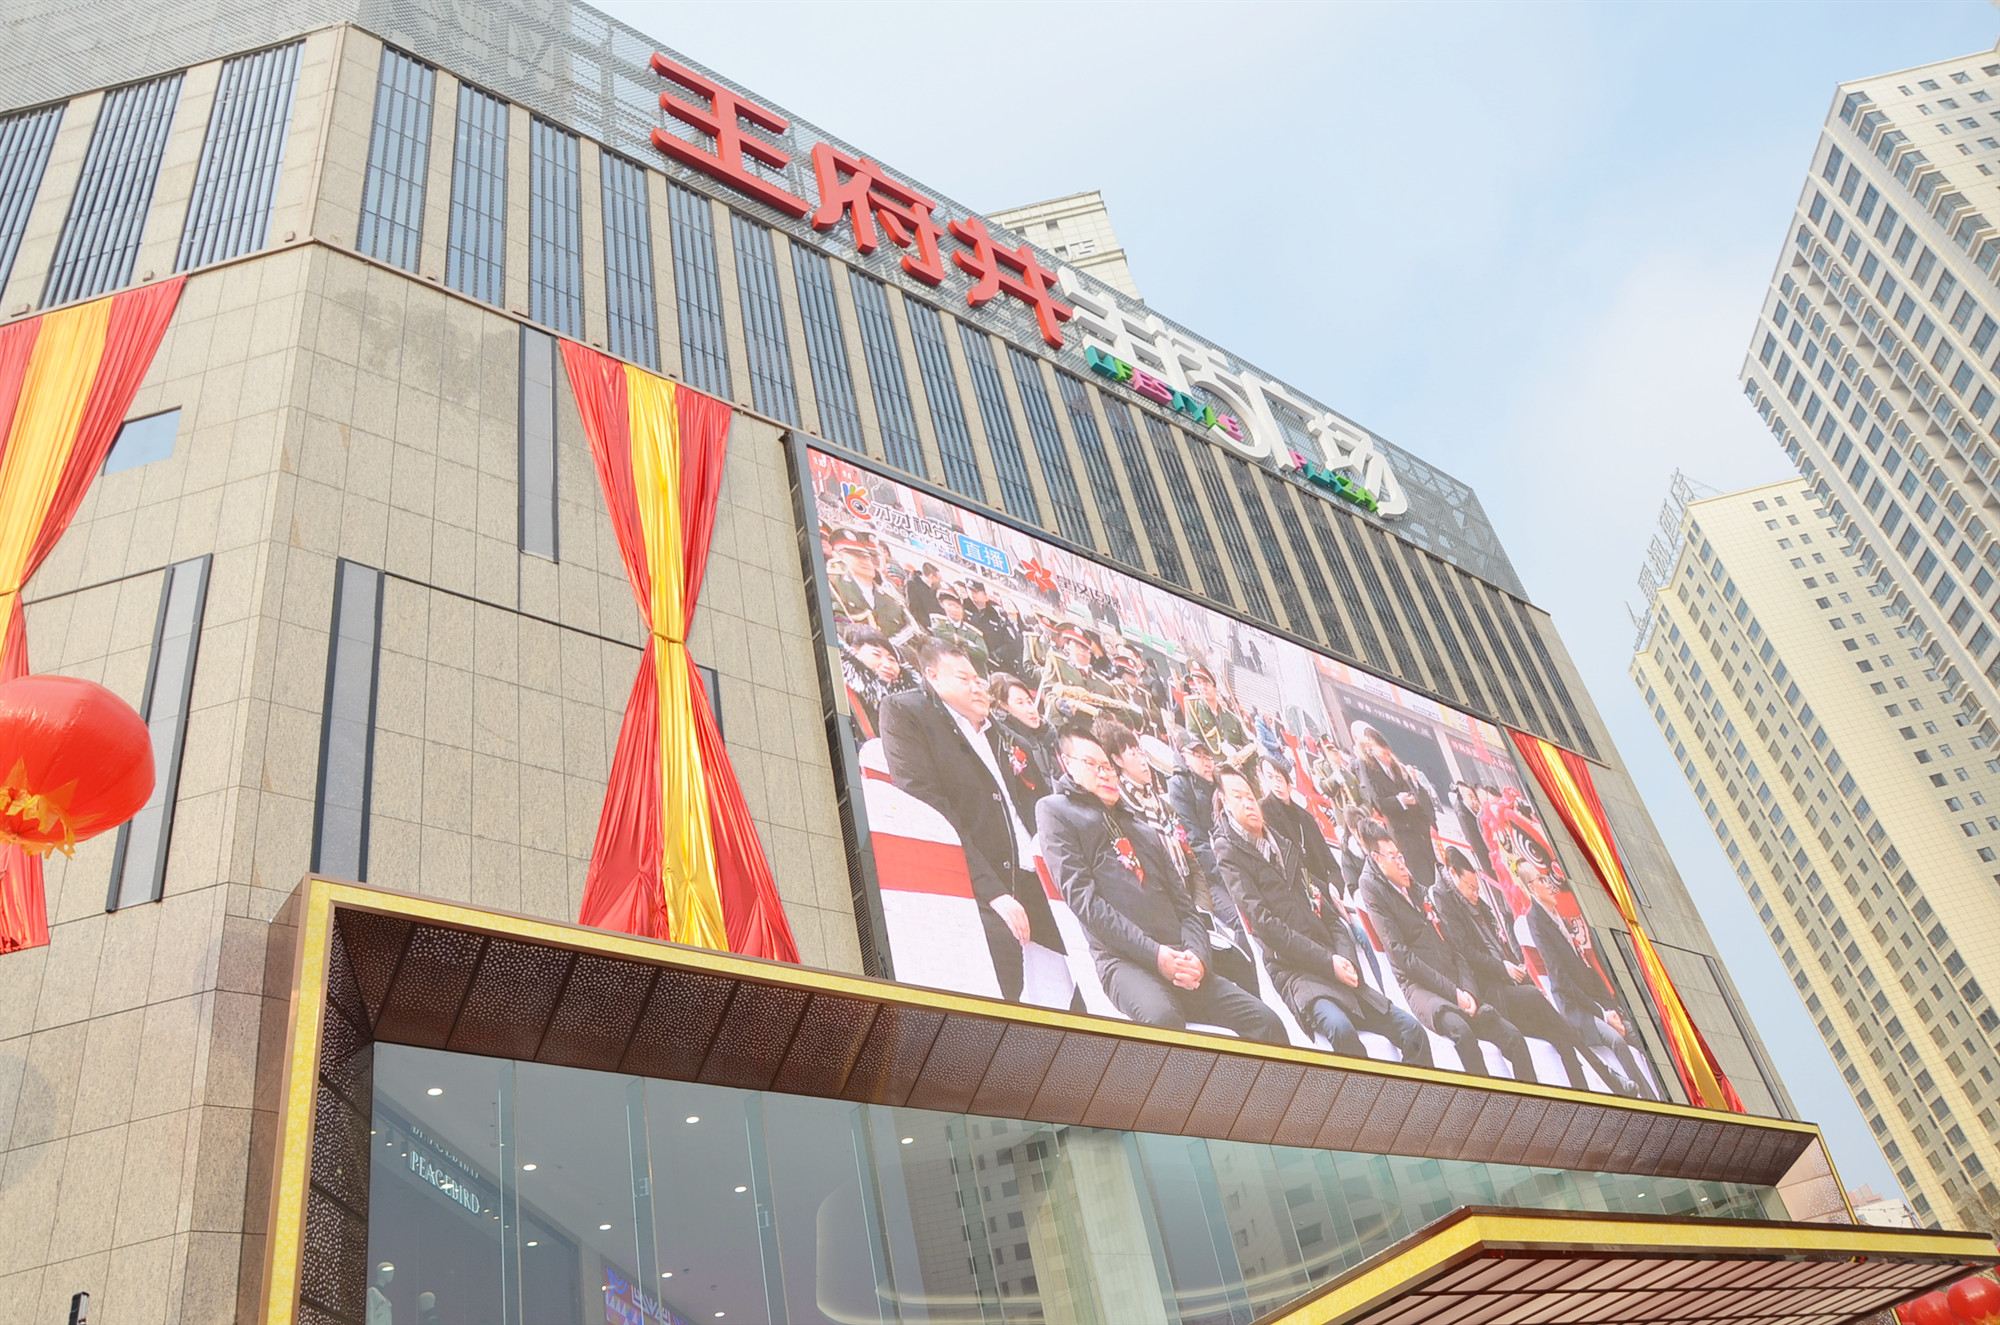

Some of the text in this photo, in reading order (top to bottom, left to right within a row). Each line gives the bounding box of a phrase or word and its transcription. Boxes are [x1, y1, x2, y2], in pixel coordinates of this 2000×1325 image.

[650, 51, 1073, 349] 王府井
[1085, 345, 1379, 512] LIFESTYLE PLAZA
[963, 539, 1005, 571] 直播
[410, 1150, 481, 1214] PEACEBIRD
